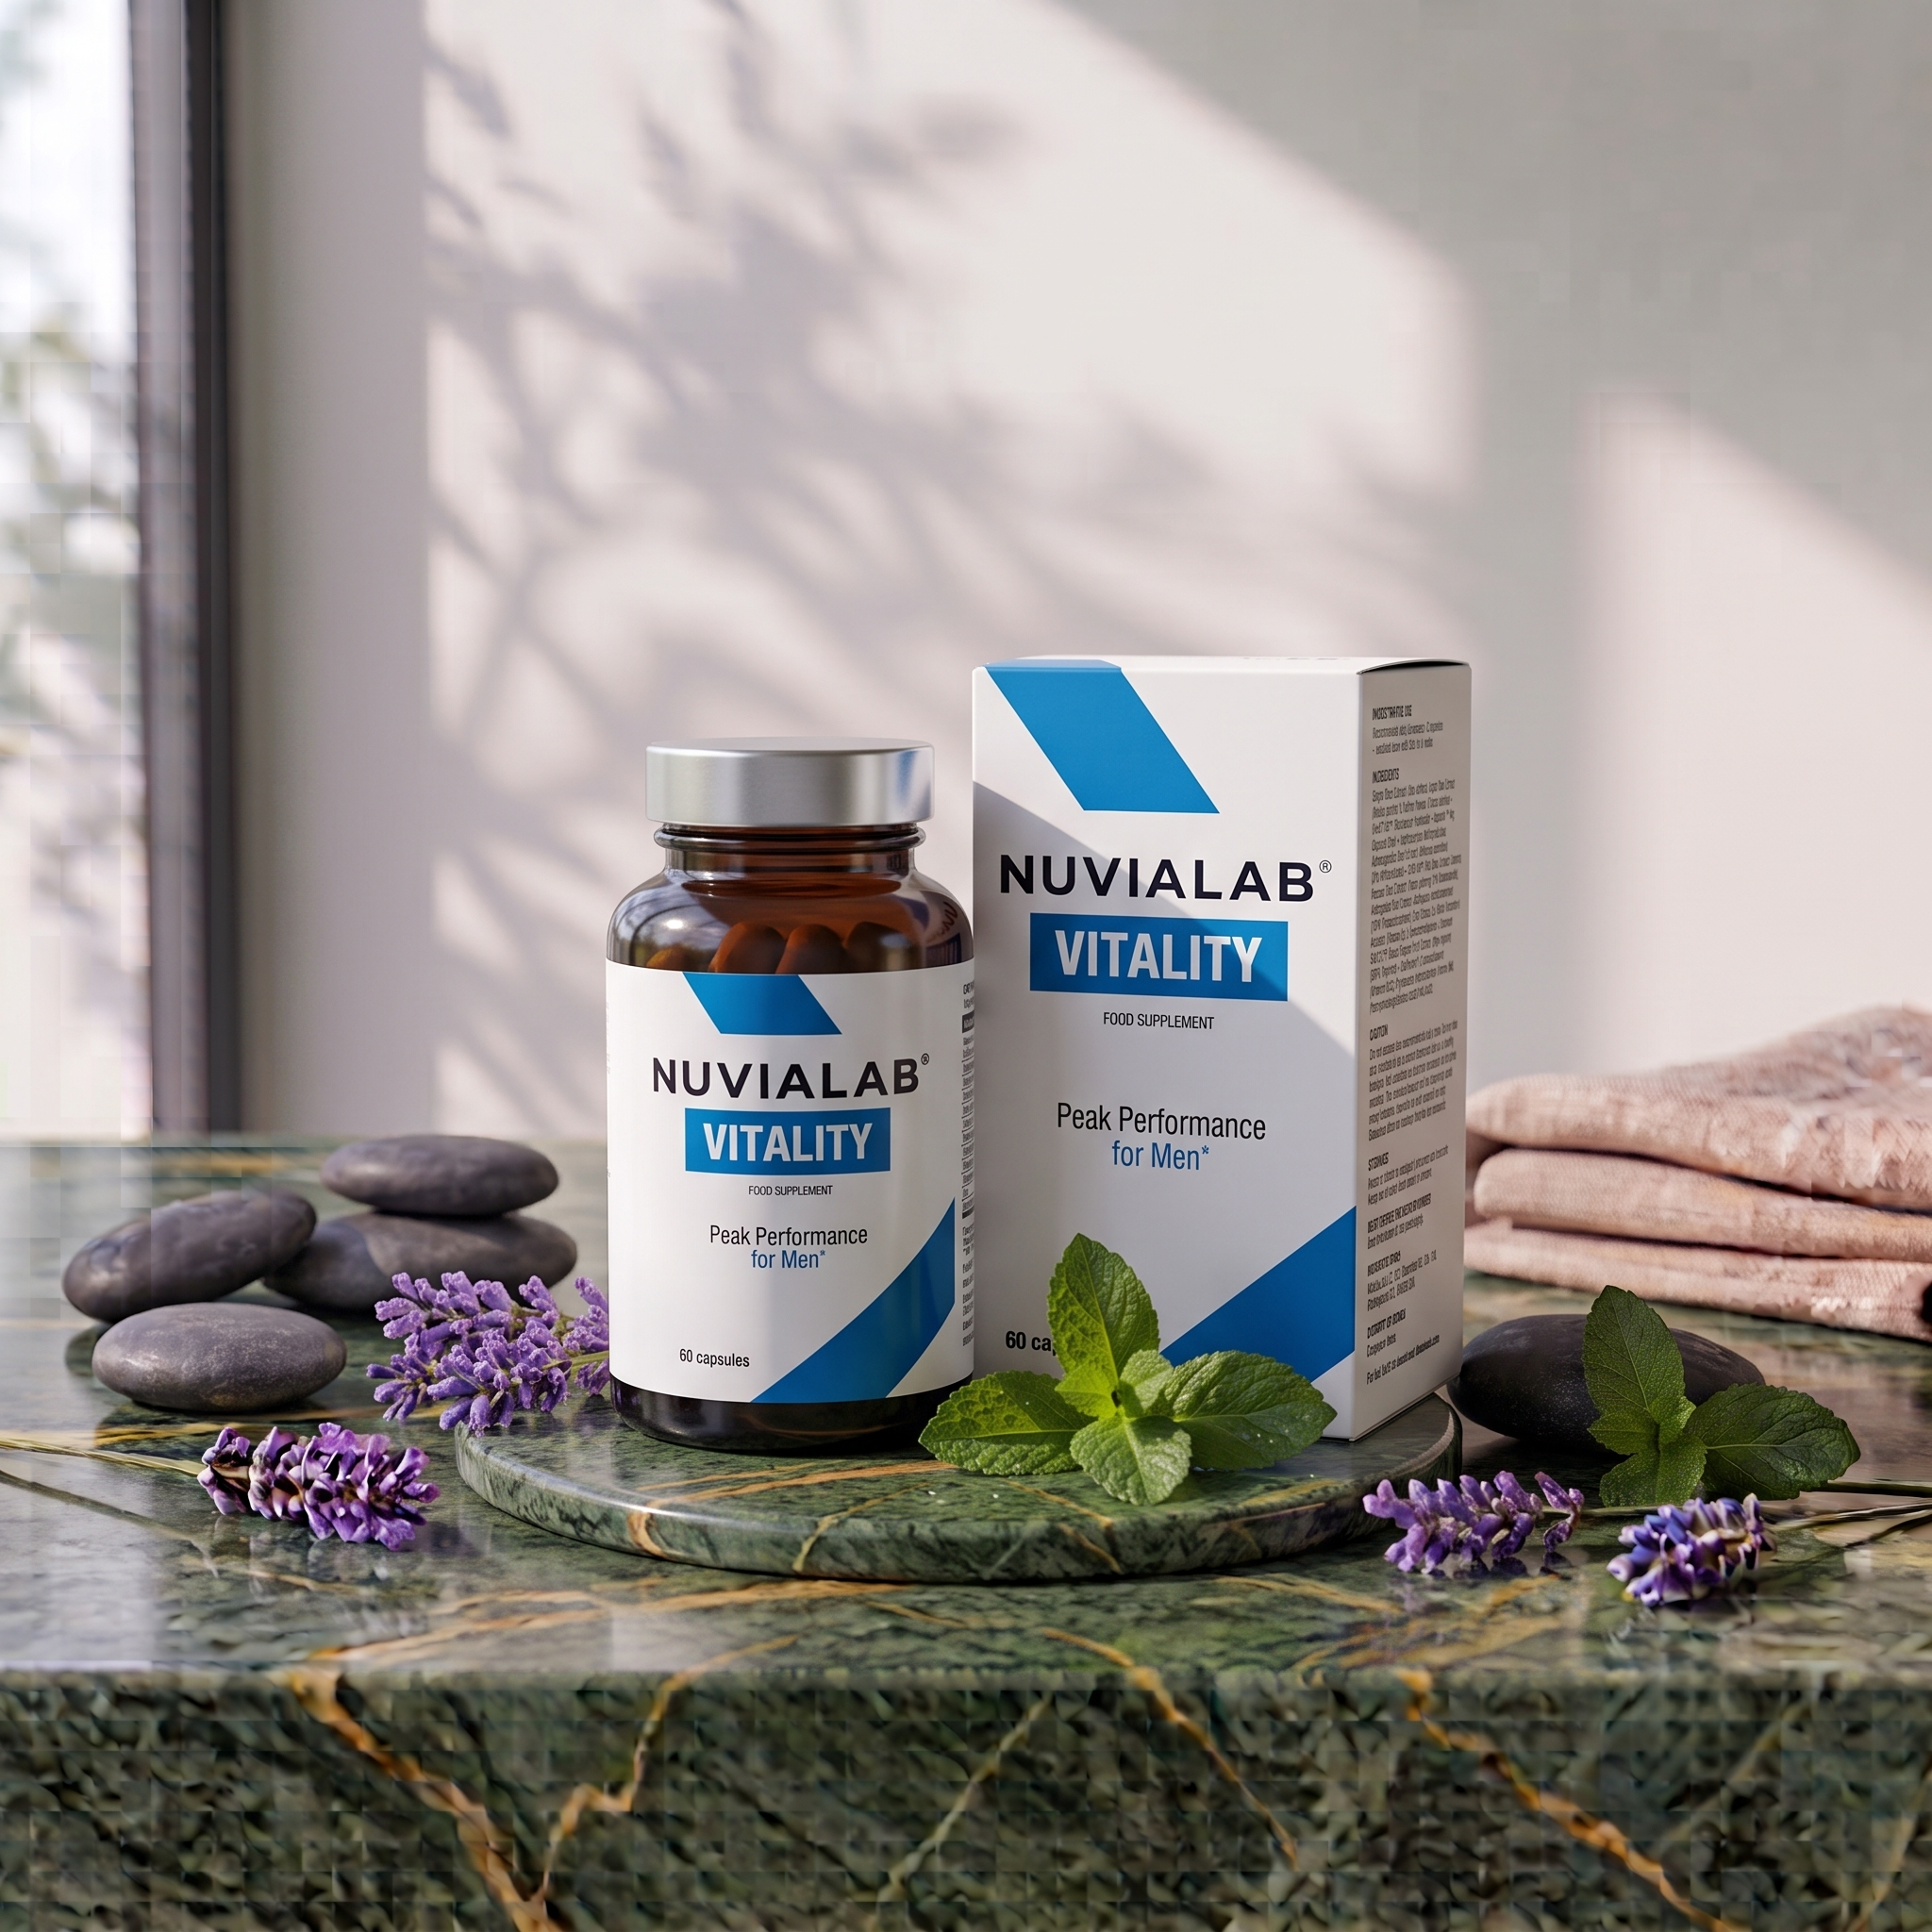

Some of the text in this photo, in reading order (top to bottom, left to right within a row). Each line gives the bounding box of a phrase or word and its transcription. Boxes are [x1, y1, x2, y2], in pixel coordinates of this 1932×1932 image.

[1056, 931, 1261, 981] VITALITY
[1104, 1012, 1214, 1029] FOOD SUPPLEMENT
[1058, 1103, 1266, 1140] Peak Performance
[704, 1124, 872, 1160] VITALITY
[1112, 1141, 1143, 1166] for
[749, 1186, 833, 1195] FOOD SUPPLEMENT
[711, 1225, 867, 1245] Peak Performance
[751, 1250, 775, 1268] for
[1006, 1331, 1025, 1349] 60
[680, 1349, 749, 1367] 60 capsules
